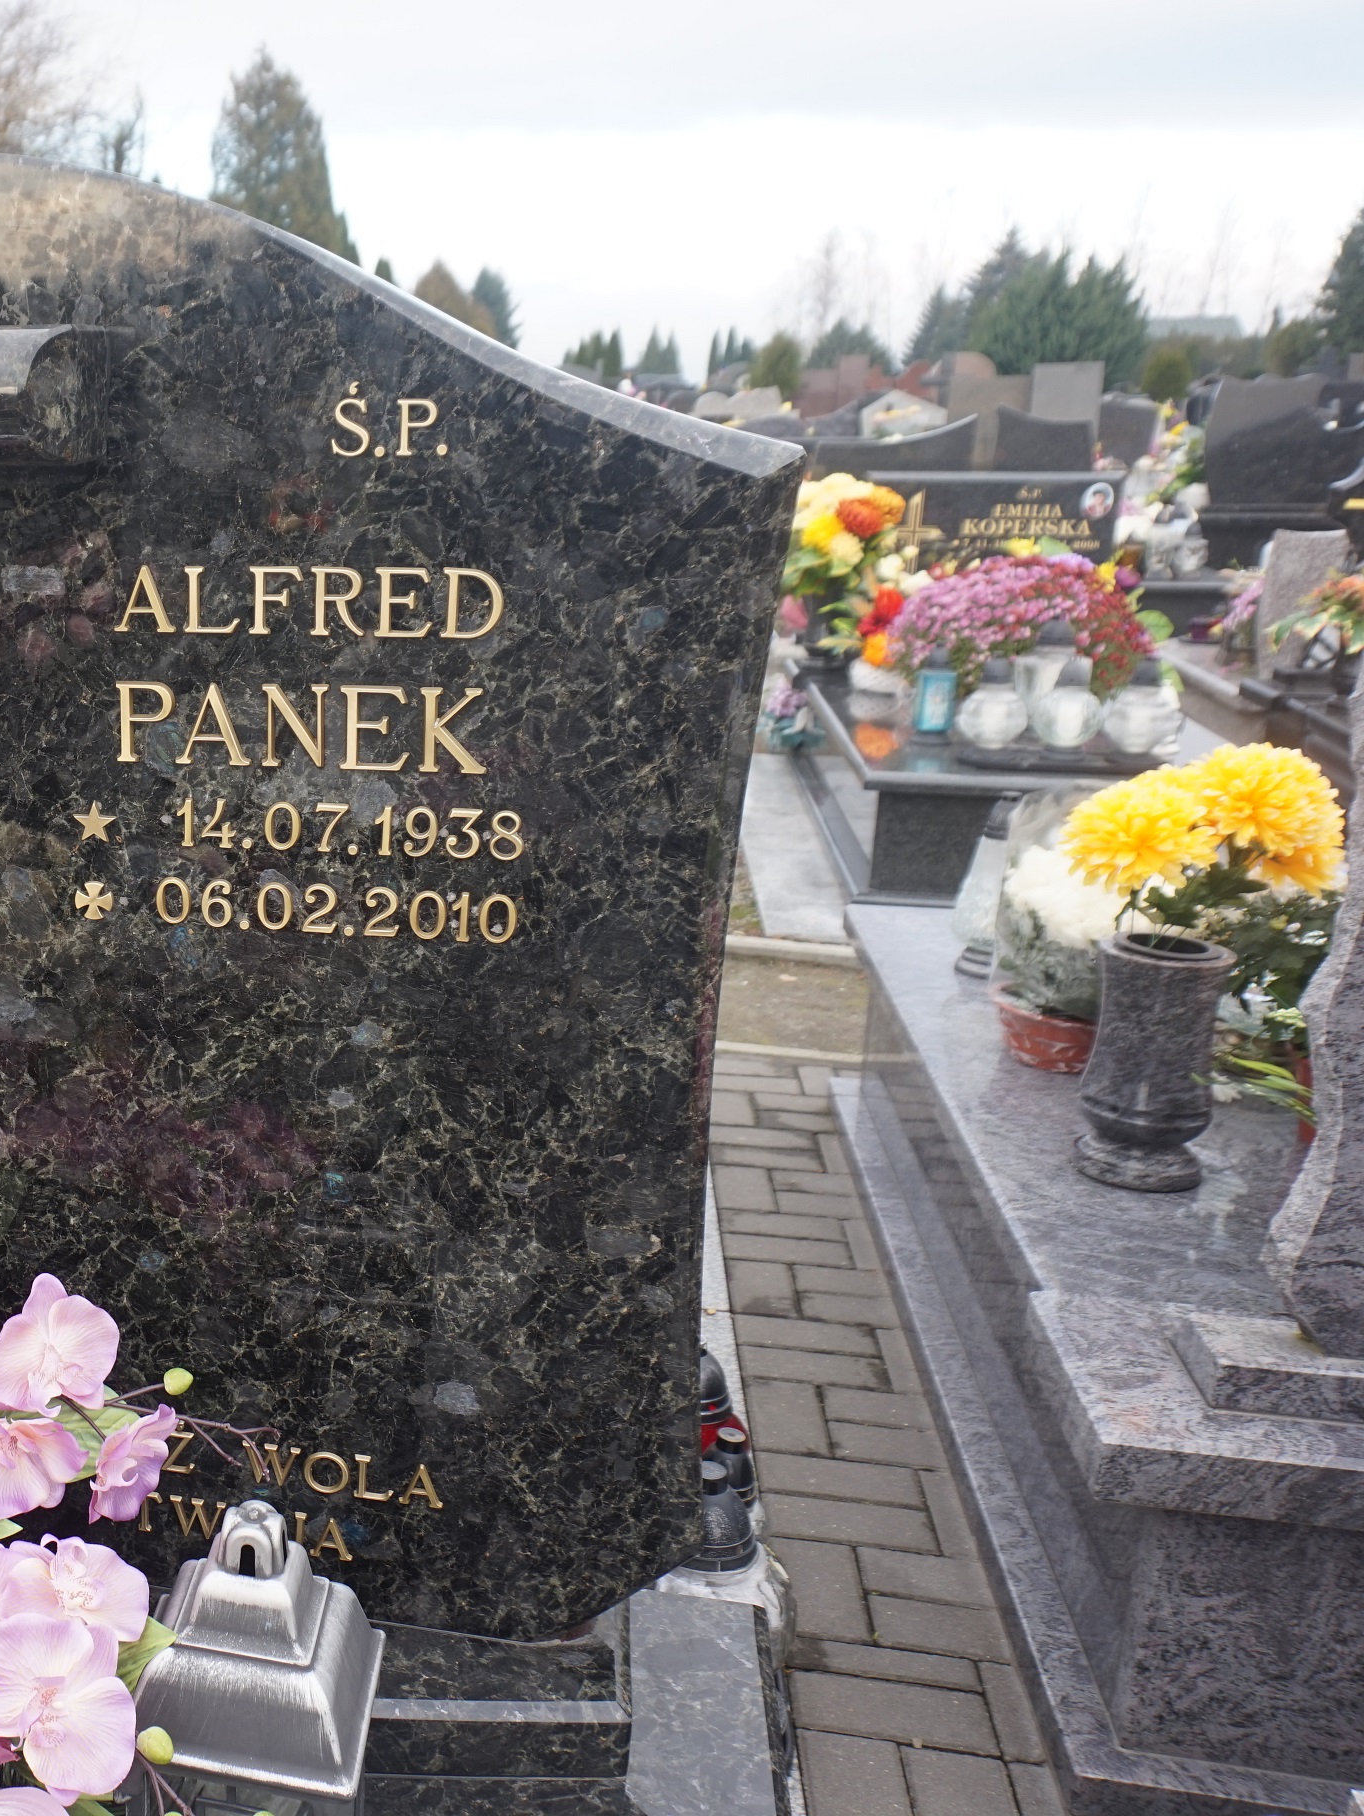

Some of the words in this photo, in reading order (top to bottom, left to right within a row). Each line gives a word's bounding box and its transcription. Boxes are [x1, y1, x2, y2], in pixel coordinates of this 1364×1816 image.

[330, 380, 449, 458] Ś.P.
[960, 518, 1092, 536] KOPERSKA
[991, 503, 1063, 518] EMILIA
[113, 564, 505, 640] ALFRED
[115, 680, 487, 776] PANEK
[176, 797, 524, 861] 14.07.1938
[155, 876, 518, 944] 06.02.2010
[241, 1439, 444, 1510] WOLA
[137, 1490, 354, 1562] TWJA
